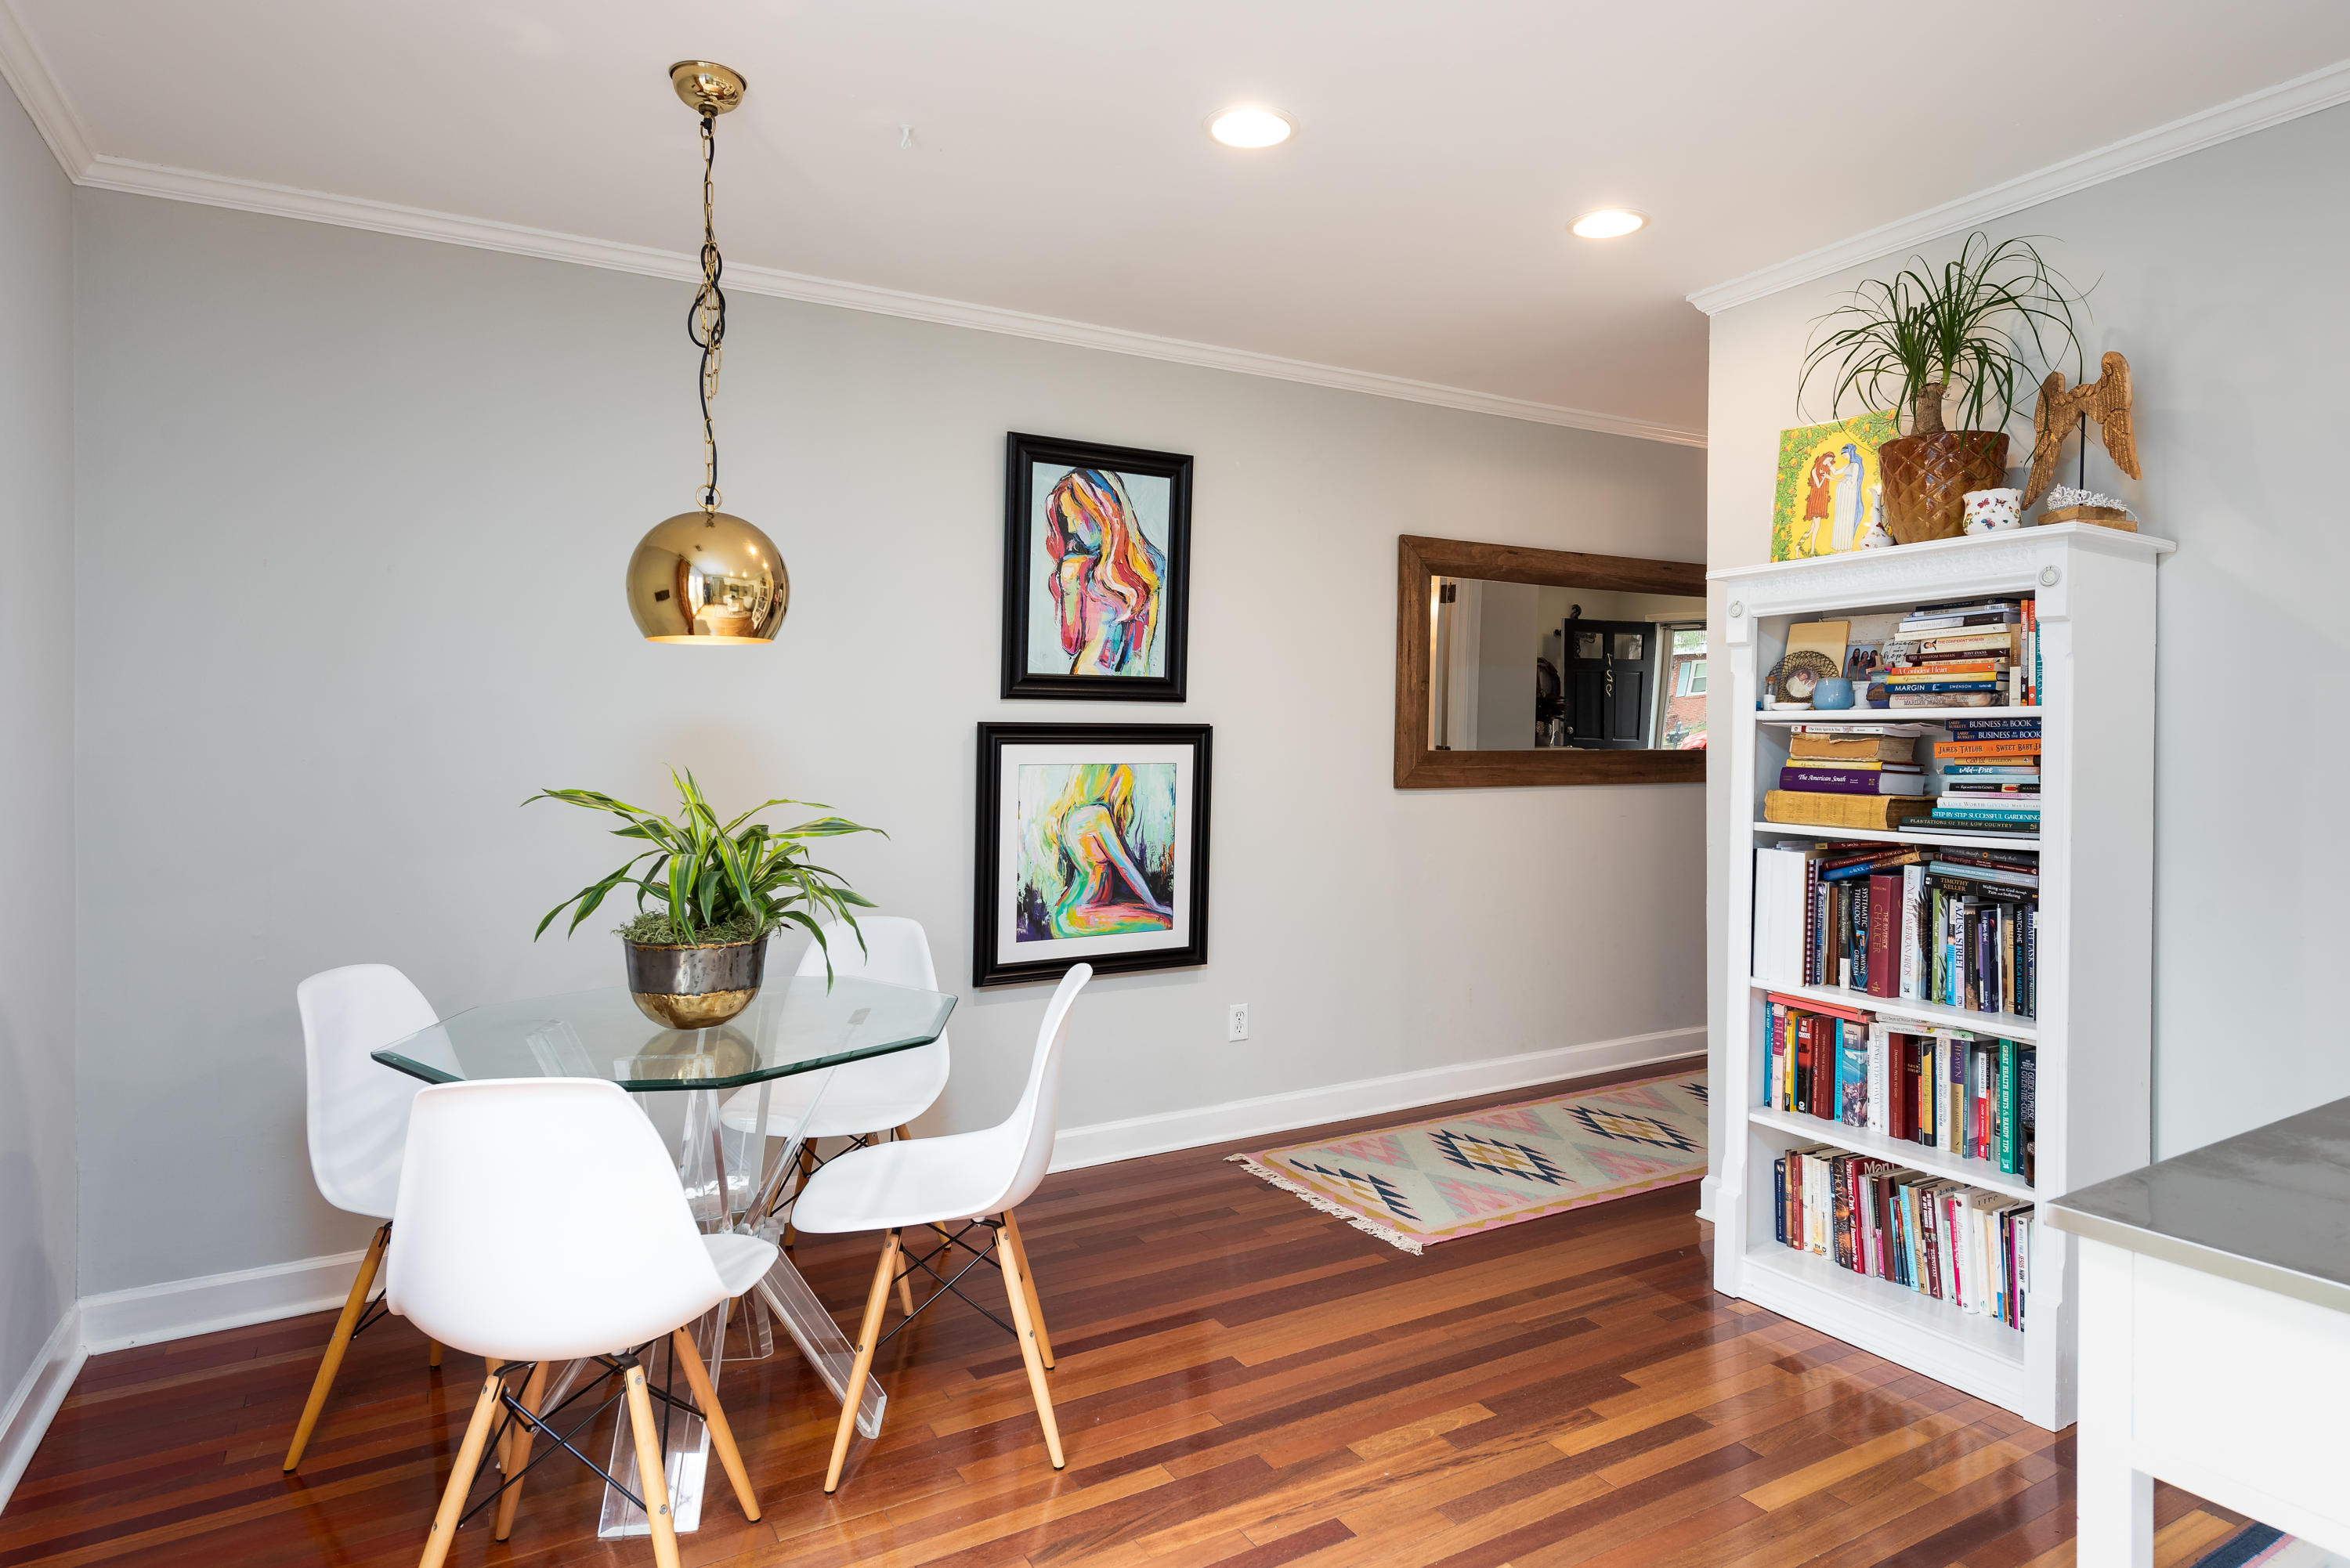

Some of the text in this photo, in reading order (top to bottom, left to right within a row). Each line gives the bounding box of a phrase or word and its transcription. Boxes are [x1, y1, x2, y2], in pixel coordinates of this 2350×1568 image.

[1938, 746, 1958, 754] JAMES
[2018, 743, 2033, 752] BABY
[1940, 878, 1968, 887] TIMOTHY
[1907, 885, 1915, 914] NORTH
[1873, 904, 1882, 953] CHAUCER
[2016, 932, 2022, 943] ME
[1955, 938, 1964, 970] STREET
